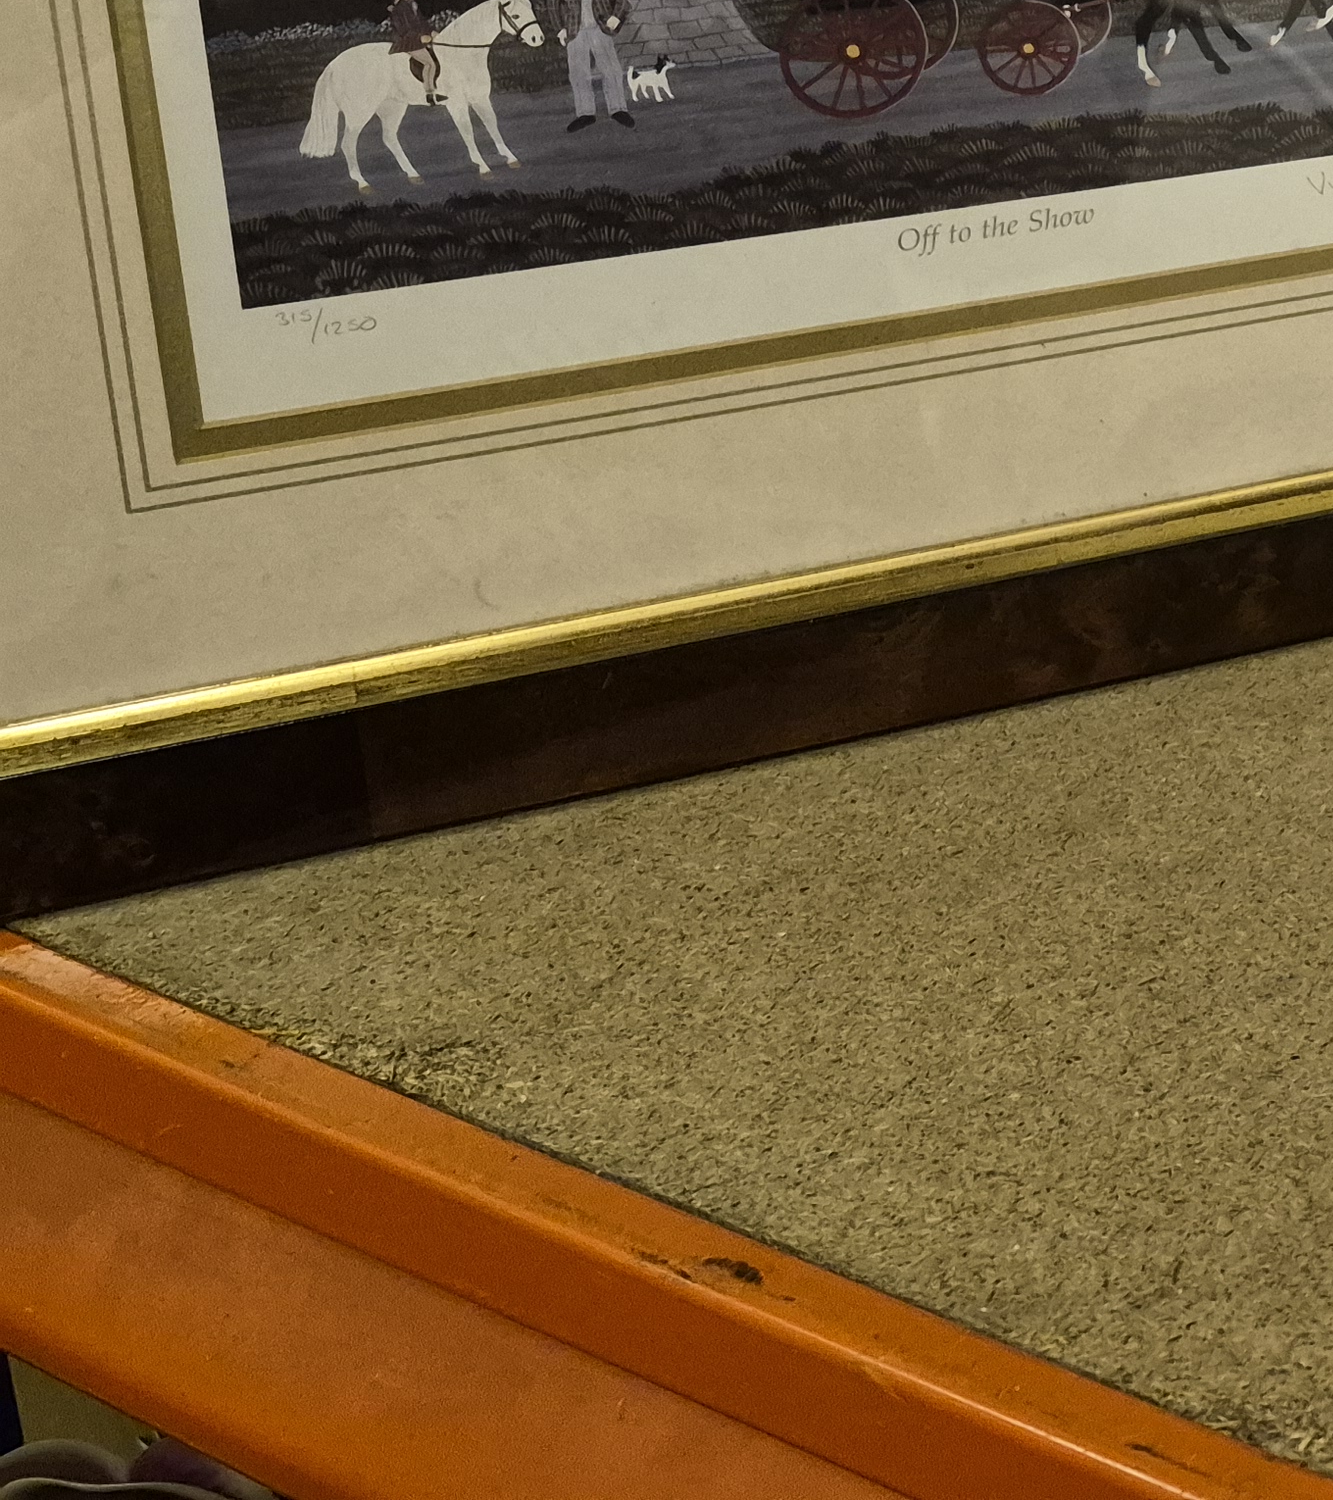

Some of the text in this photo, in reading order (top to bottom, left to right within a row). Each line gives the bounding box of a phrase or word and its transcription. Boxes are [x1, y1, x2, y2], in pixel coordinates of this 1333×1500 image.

[897, 207, 1095, 257] Off to the Show
